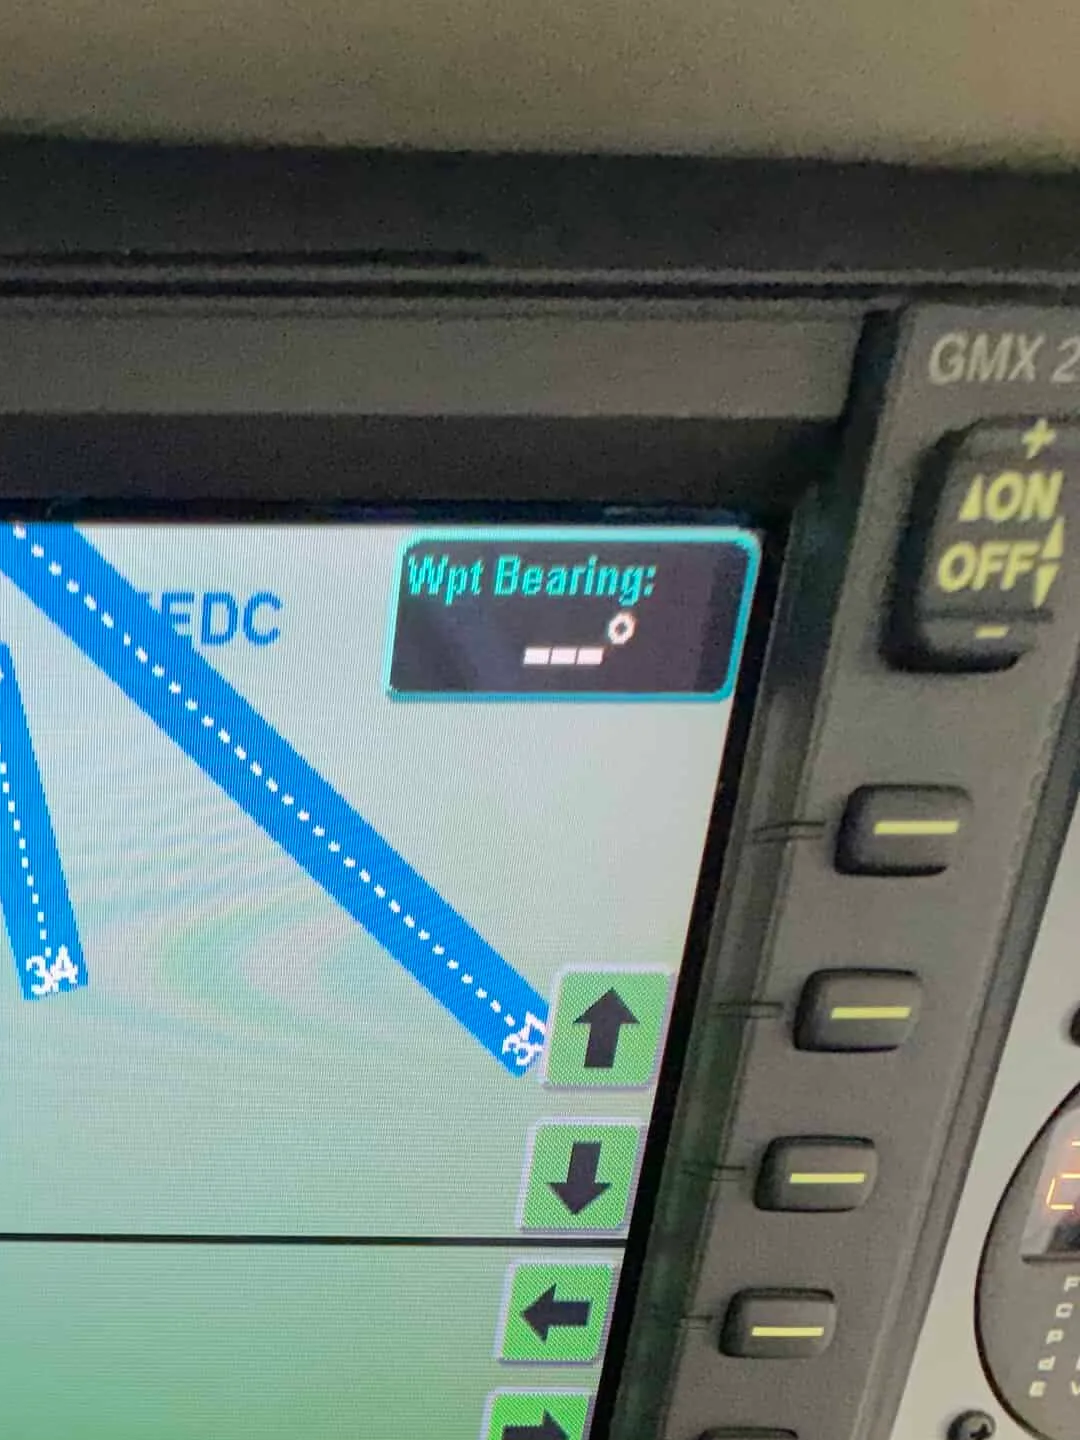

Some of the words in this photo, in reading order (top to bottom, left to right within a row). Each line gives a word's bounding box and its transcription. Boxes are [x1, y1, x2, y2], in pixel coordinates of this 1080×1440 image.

[928, 331, 1044, 385] GMX
[985, 471, 1063, 522] ON
[408, 554, 483, 605] Wpt
[494, 553, 657, 606] Bearing:
[938, 541, 1042, 593] OFF
[138, 592, 283, 646] EDC
[26, 944, 78, 995] 34
